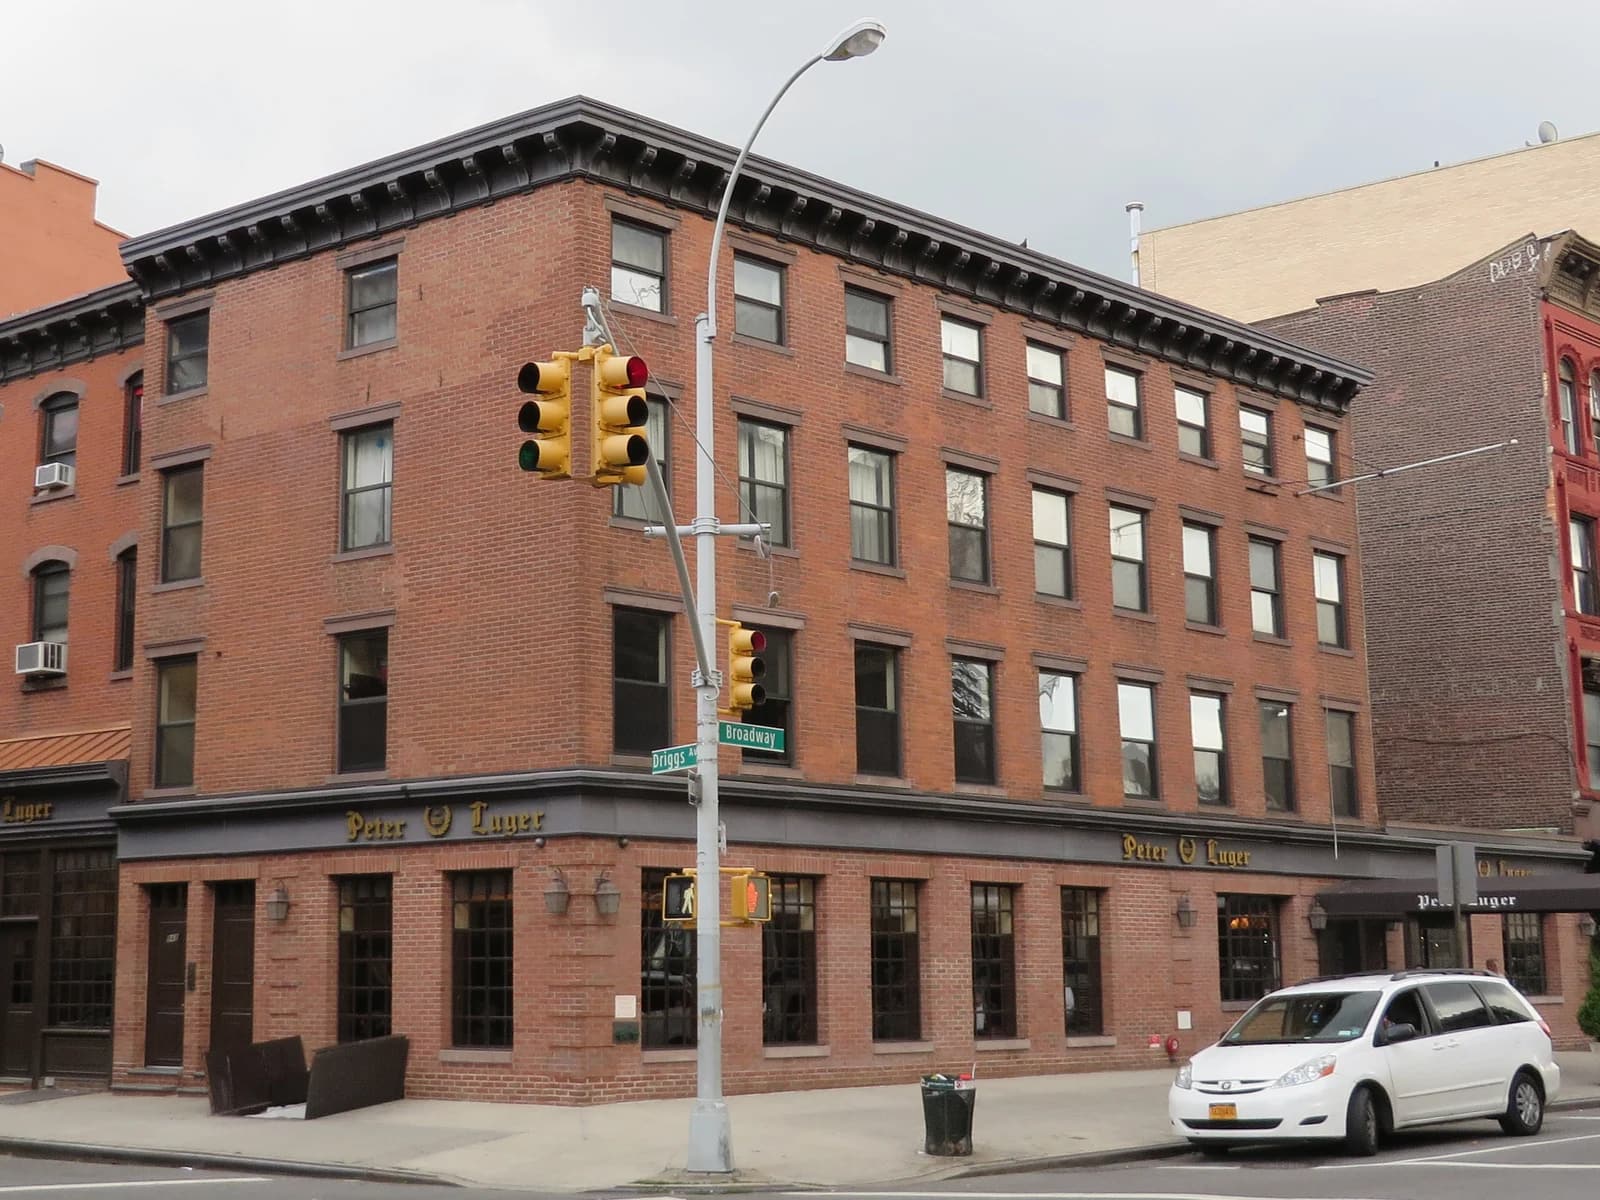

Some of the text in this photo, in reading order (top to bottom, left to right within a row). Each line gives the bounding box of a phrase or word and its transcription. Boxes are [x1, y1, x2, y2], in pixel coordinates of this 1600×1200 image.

[726, 724, 776, 748] Broadway
[653, 751, 685, 770] Driggs
[346, 801, 545, 840] Peter Luger
[1122, 833, 1251, 869] Peter Luger
[1467, 895, 1517, 908] uger
